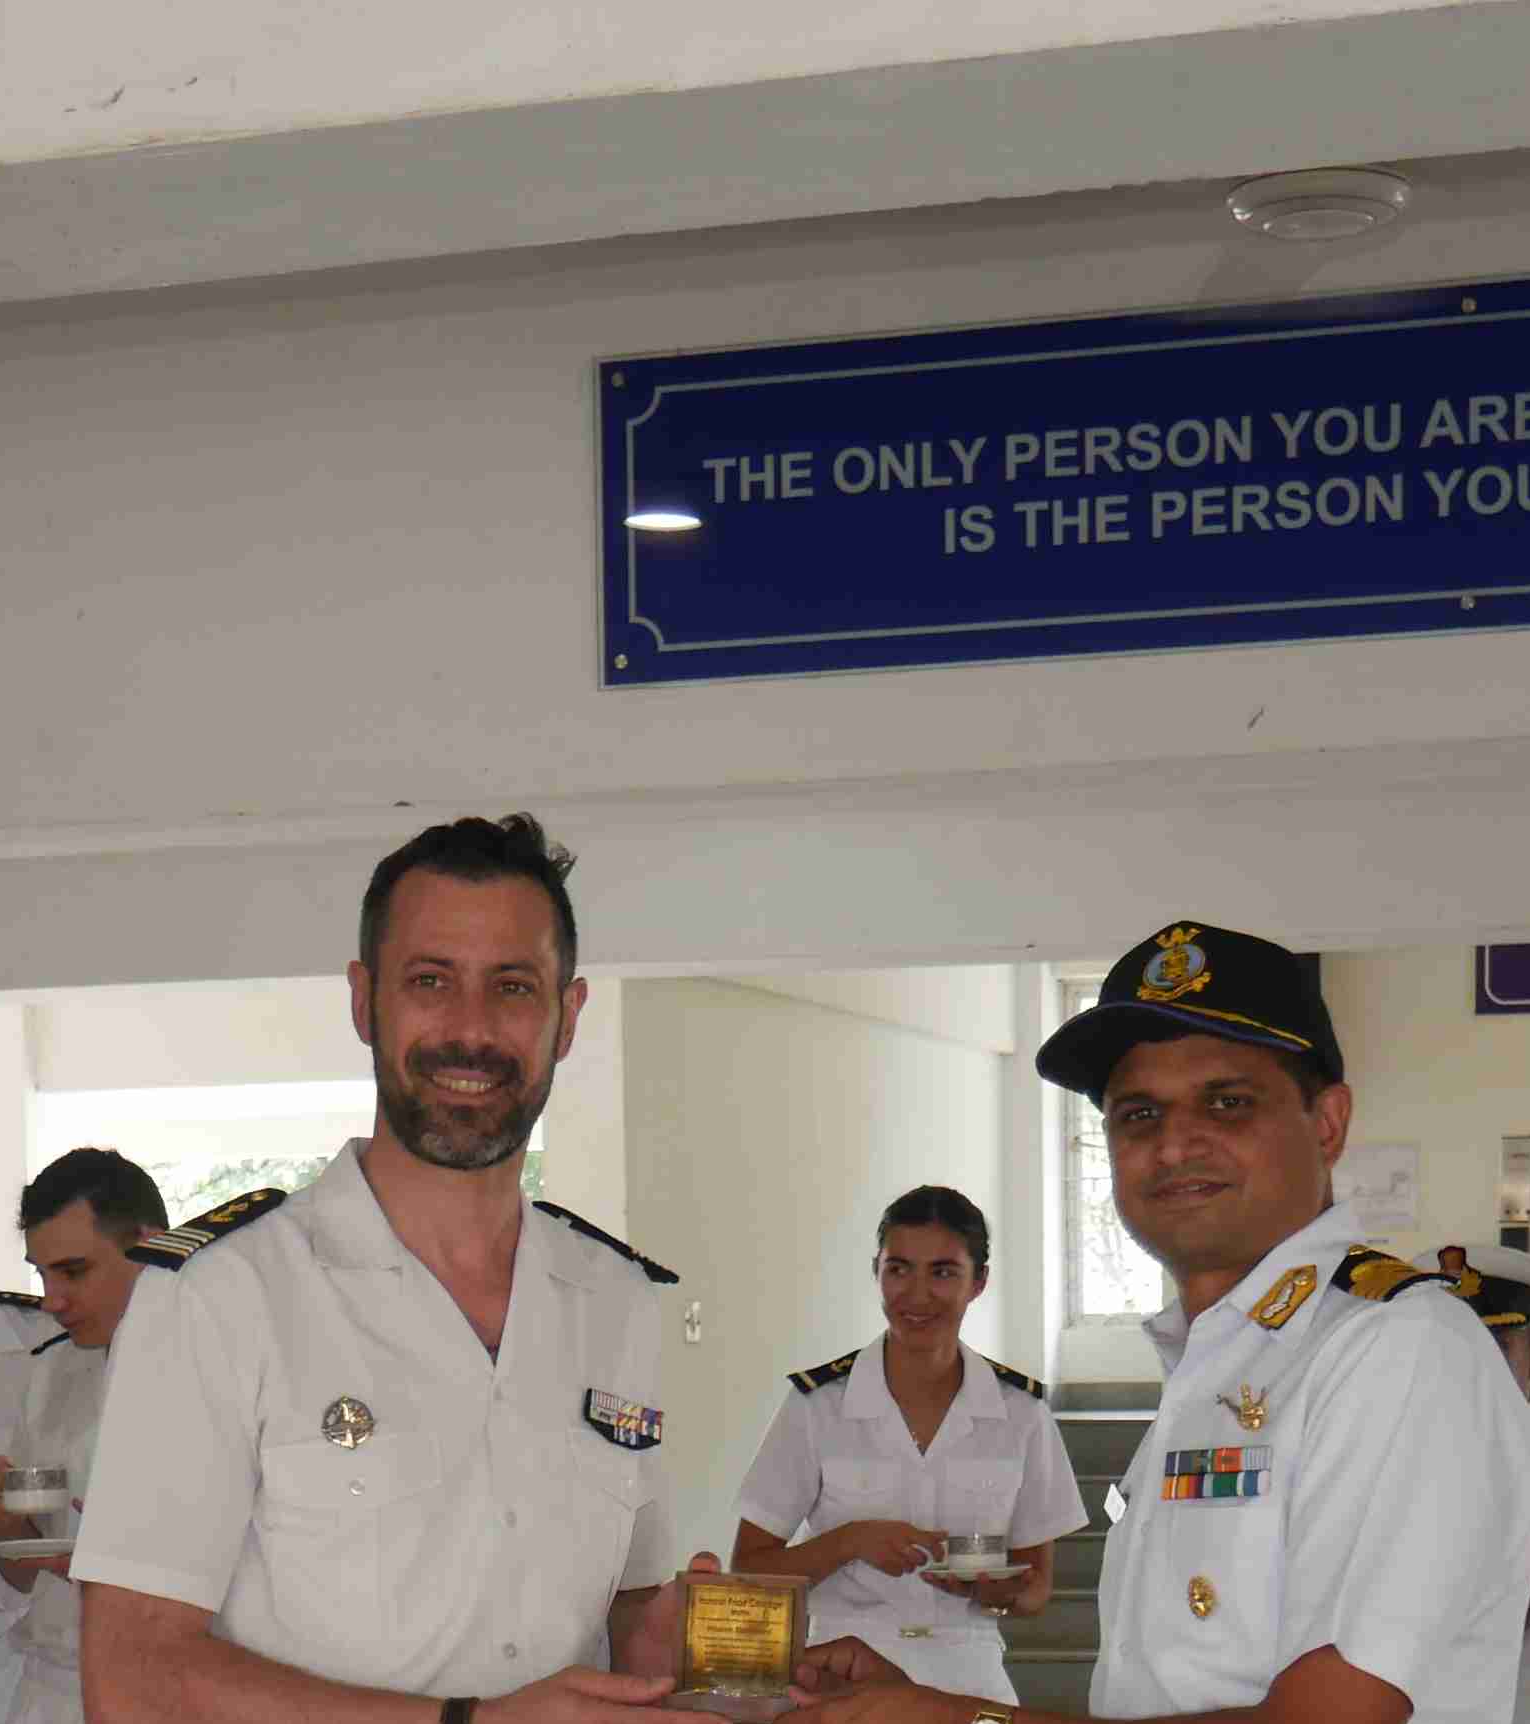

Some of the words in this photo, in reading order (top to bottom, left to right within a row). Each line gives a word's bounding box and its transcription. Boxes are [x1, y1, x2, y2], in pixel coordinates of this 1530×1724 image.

[703, 451, 814, 504] THE
[833, 437, 987, 494] ONLY
[1006, 415, 1251, 481] PERSON
[1272, 403, 1401, 458] YOU
[944, 505, 995, 554] IS
[1013, 495, 1130, 548] THE
[1152, 474, 1403, 539] PERSON
